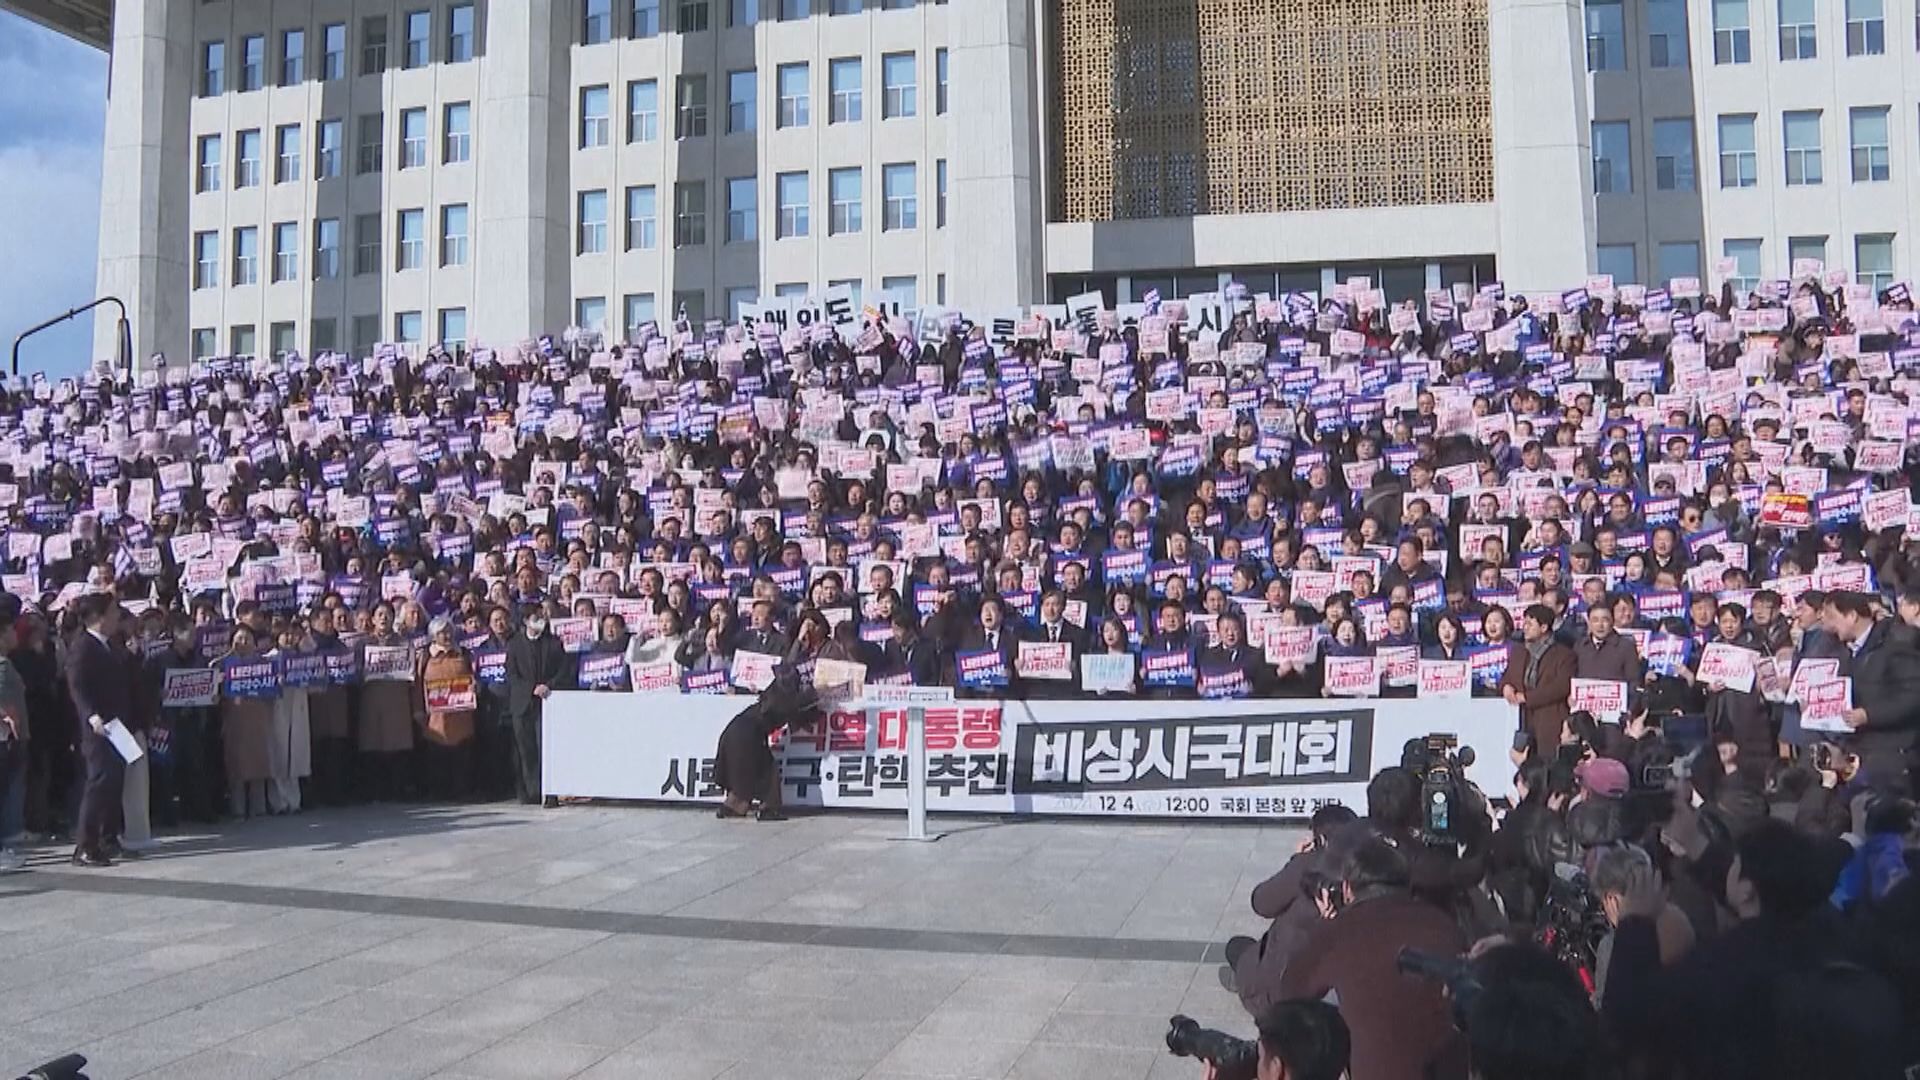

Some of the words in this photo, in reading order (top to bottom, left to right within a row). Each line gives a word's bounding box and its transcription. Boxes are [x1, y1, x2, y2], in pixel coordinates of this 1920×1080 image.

[878, 707, 1002, 750] 대통령
[1031, 718, 1353, 783] 비상시국대회
[1165, 796, 1210, 812] 12:00
[1220, 797, 1251, 813] 국회
[1255, 797, 1286, 813] 본청
[1291, 798, 1306, 813] 앞
